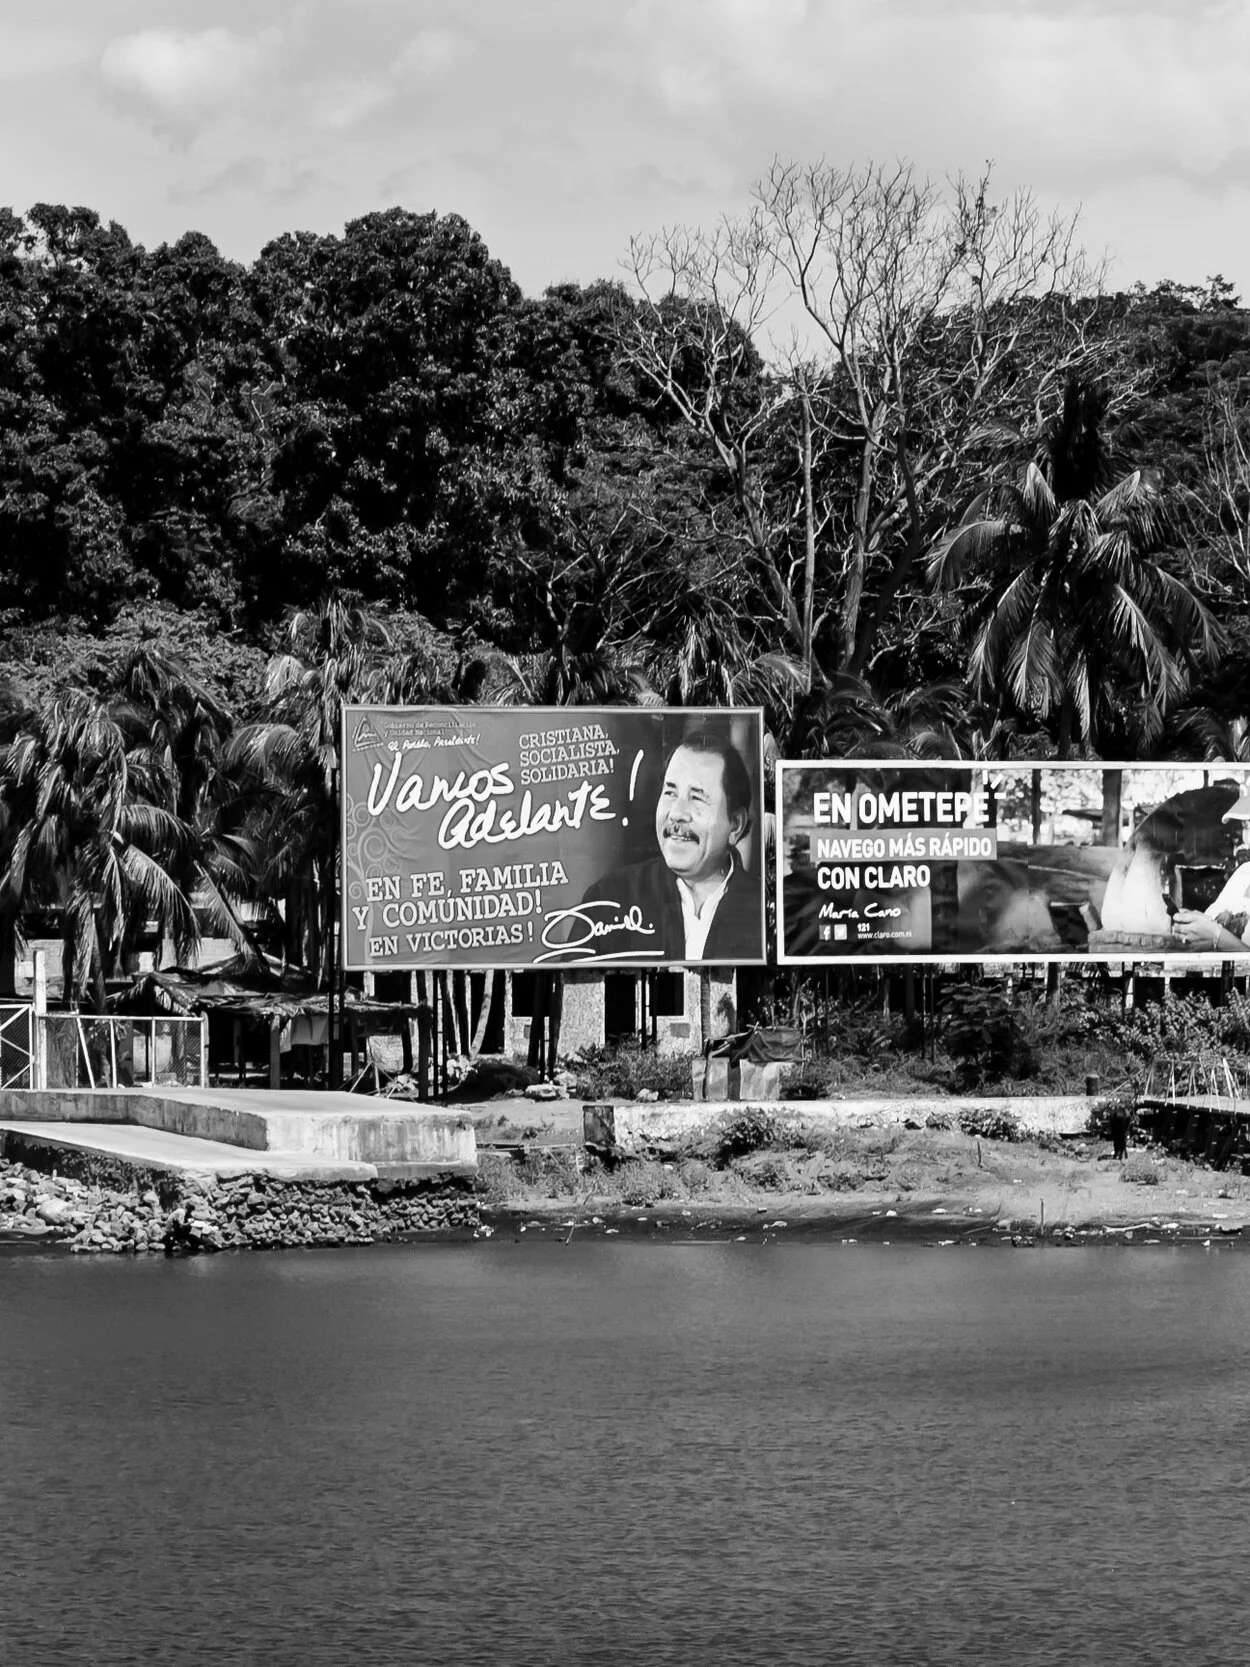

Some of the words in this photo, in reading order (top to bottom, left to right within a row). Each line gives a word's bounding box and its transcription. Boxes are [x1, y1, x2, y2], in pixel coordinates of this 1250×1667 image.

[519, 724, 609, 750] CRISTIANA,
[519, 739, 620, 768] SOCIALISTA,
[366, 751, 515, 817] Vamos
[520, 758, 614, 785] SOLIDARIA!
[814, 792, 851, 823] EN
[858, 791, 990, 824] OMETEPE
[817, 838, 886, 859] NAVEGO
[889, 832, 926, 858] MÁS
[929, 832, 992, 858] RÁPIDO
[366, 877, 405, 902] EN
[410, 871, 452, 899] FE,
[459, 860, 569, 892] FAMILIA
[817, 866, 860, 890] CON
[864, 864, 931, 889] CLARO
[351, 904, 370, 931] Y
[382, 889, 543, 929] COMUNIDAD!
[863, 902, 902, 918] Cano
[368, 934, 398, 958] EN
[406, 922, 535, 955] VICTORIAS!
[857, 922, 870, 933] 121
